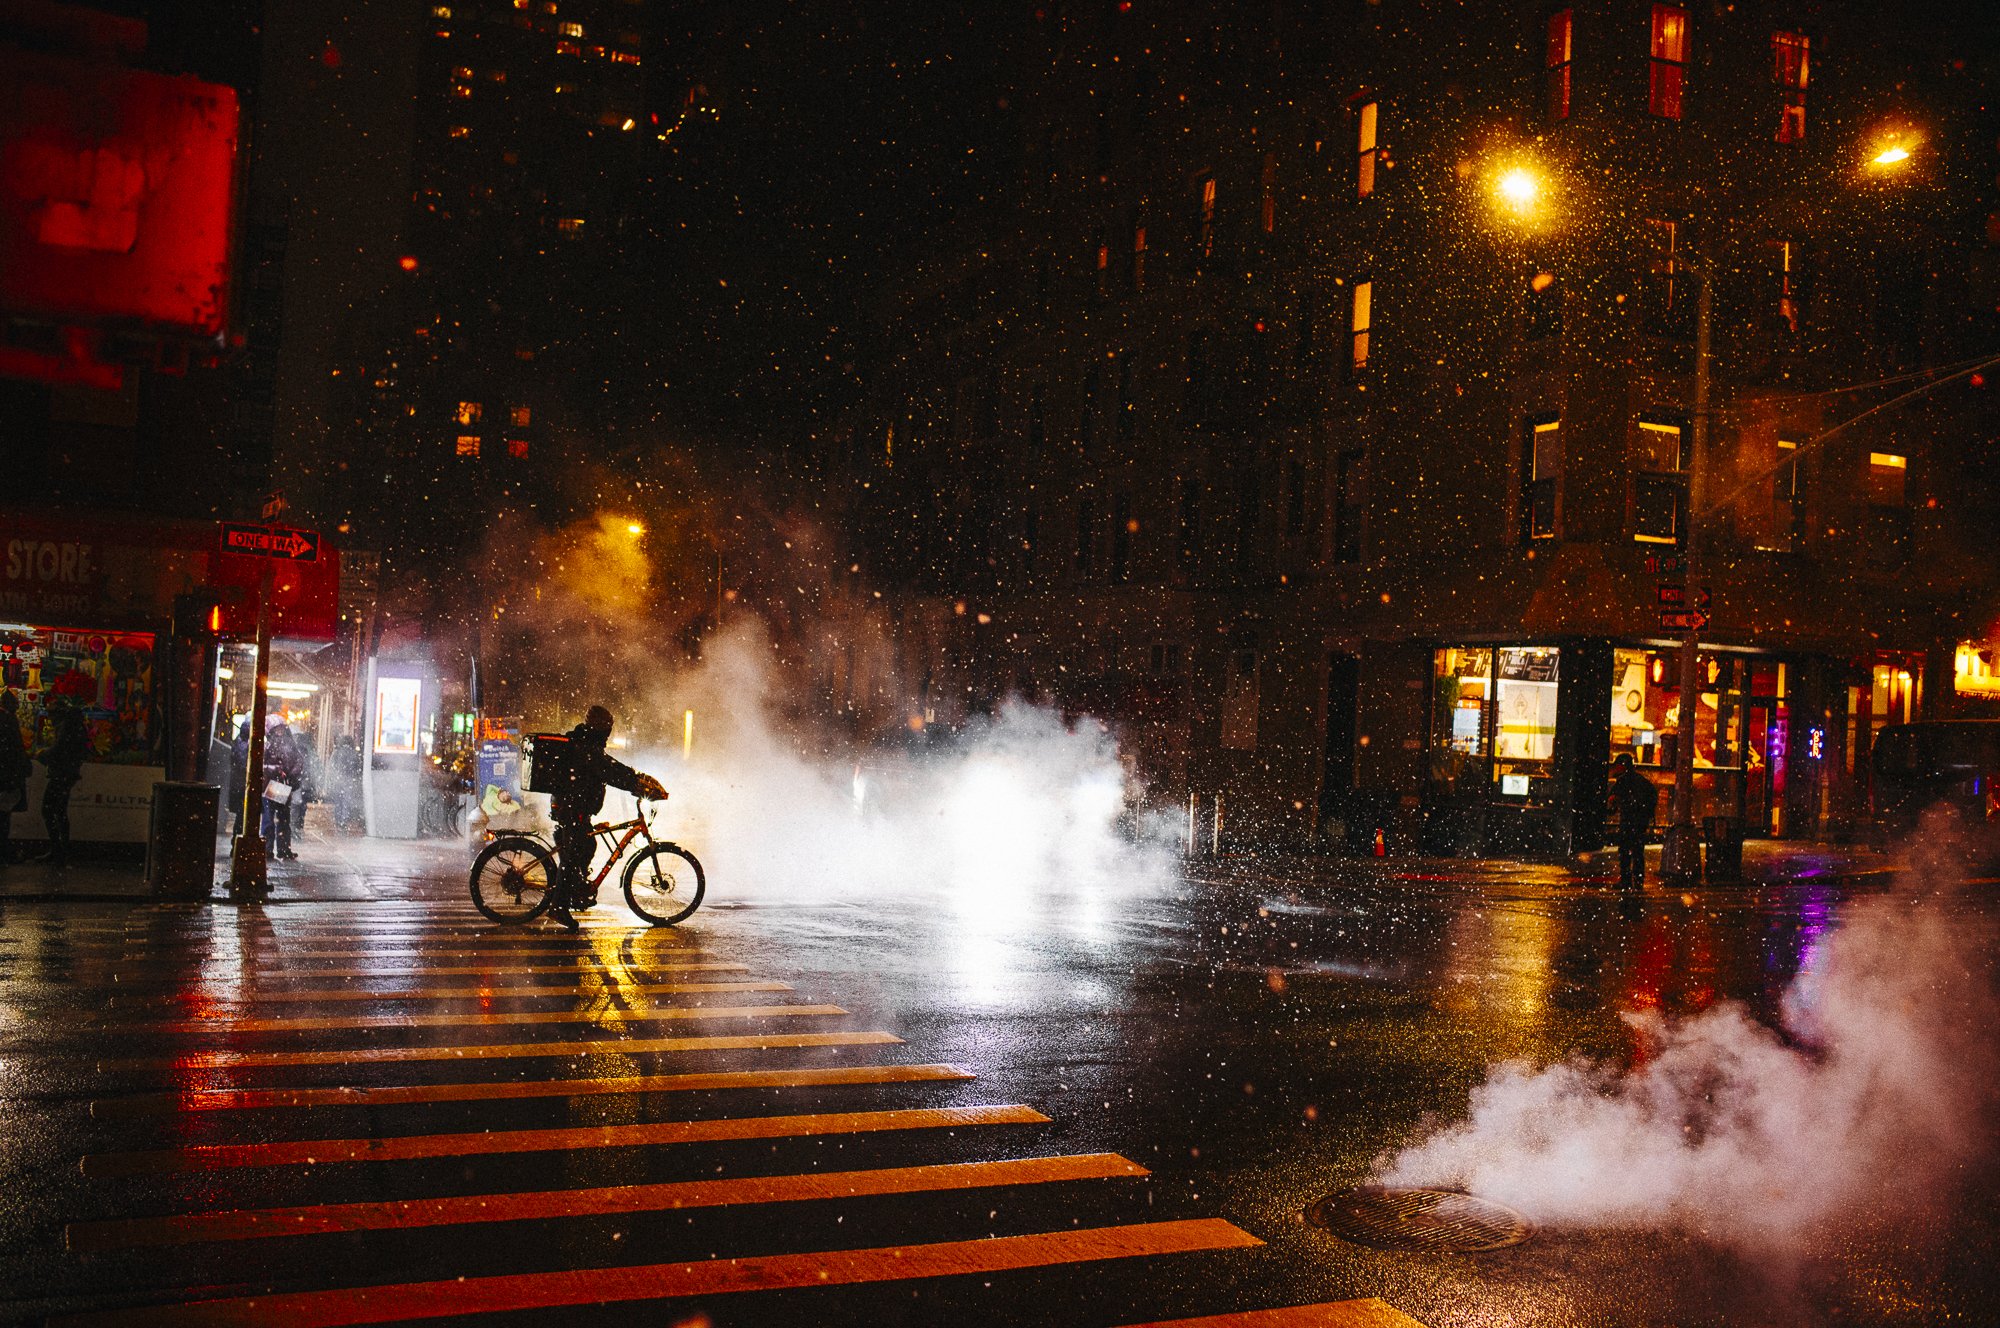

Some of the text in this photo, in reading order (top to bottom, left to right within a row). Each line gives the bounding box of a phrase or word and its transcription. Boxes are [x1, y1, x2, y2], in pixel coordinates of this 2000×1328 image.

[236, 533, 303, 551] ONE WAY
[6, 538, 92, 583] STORE
